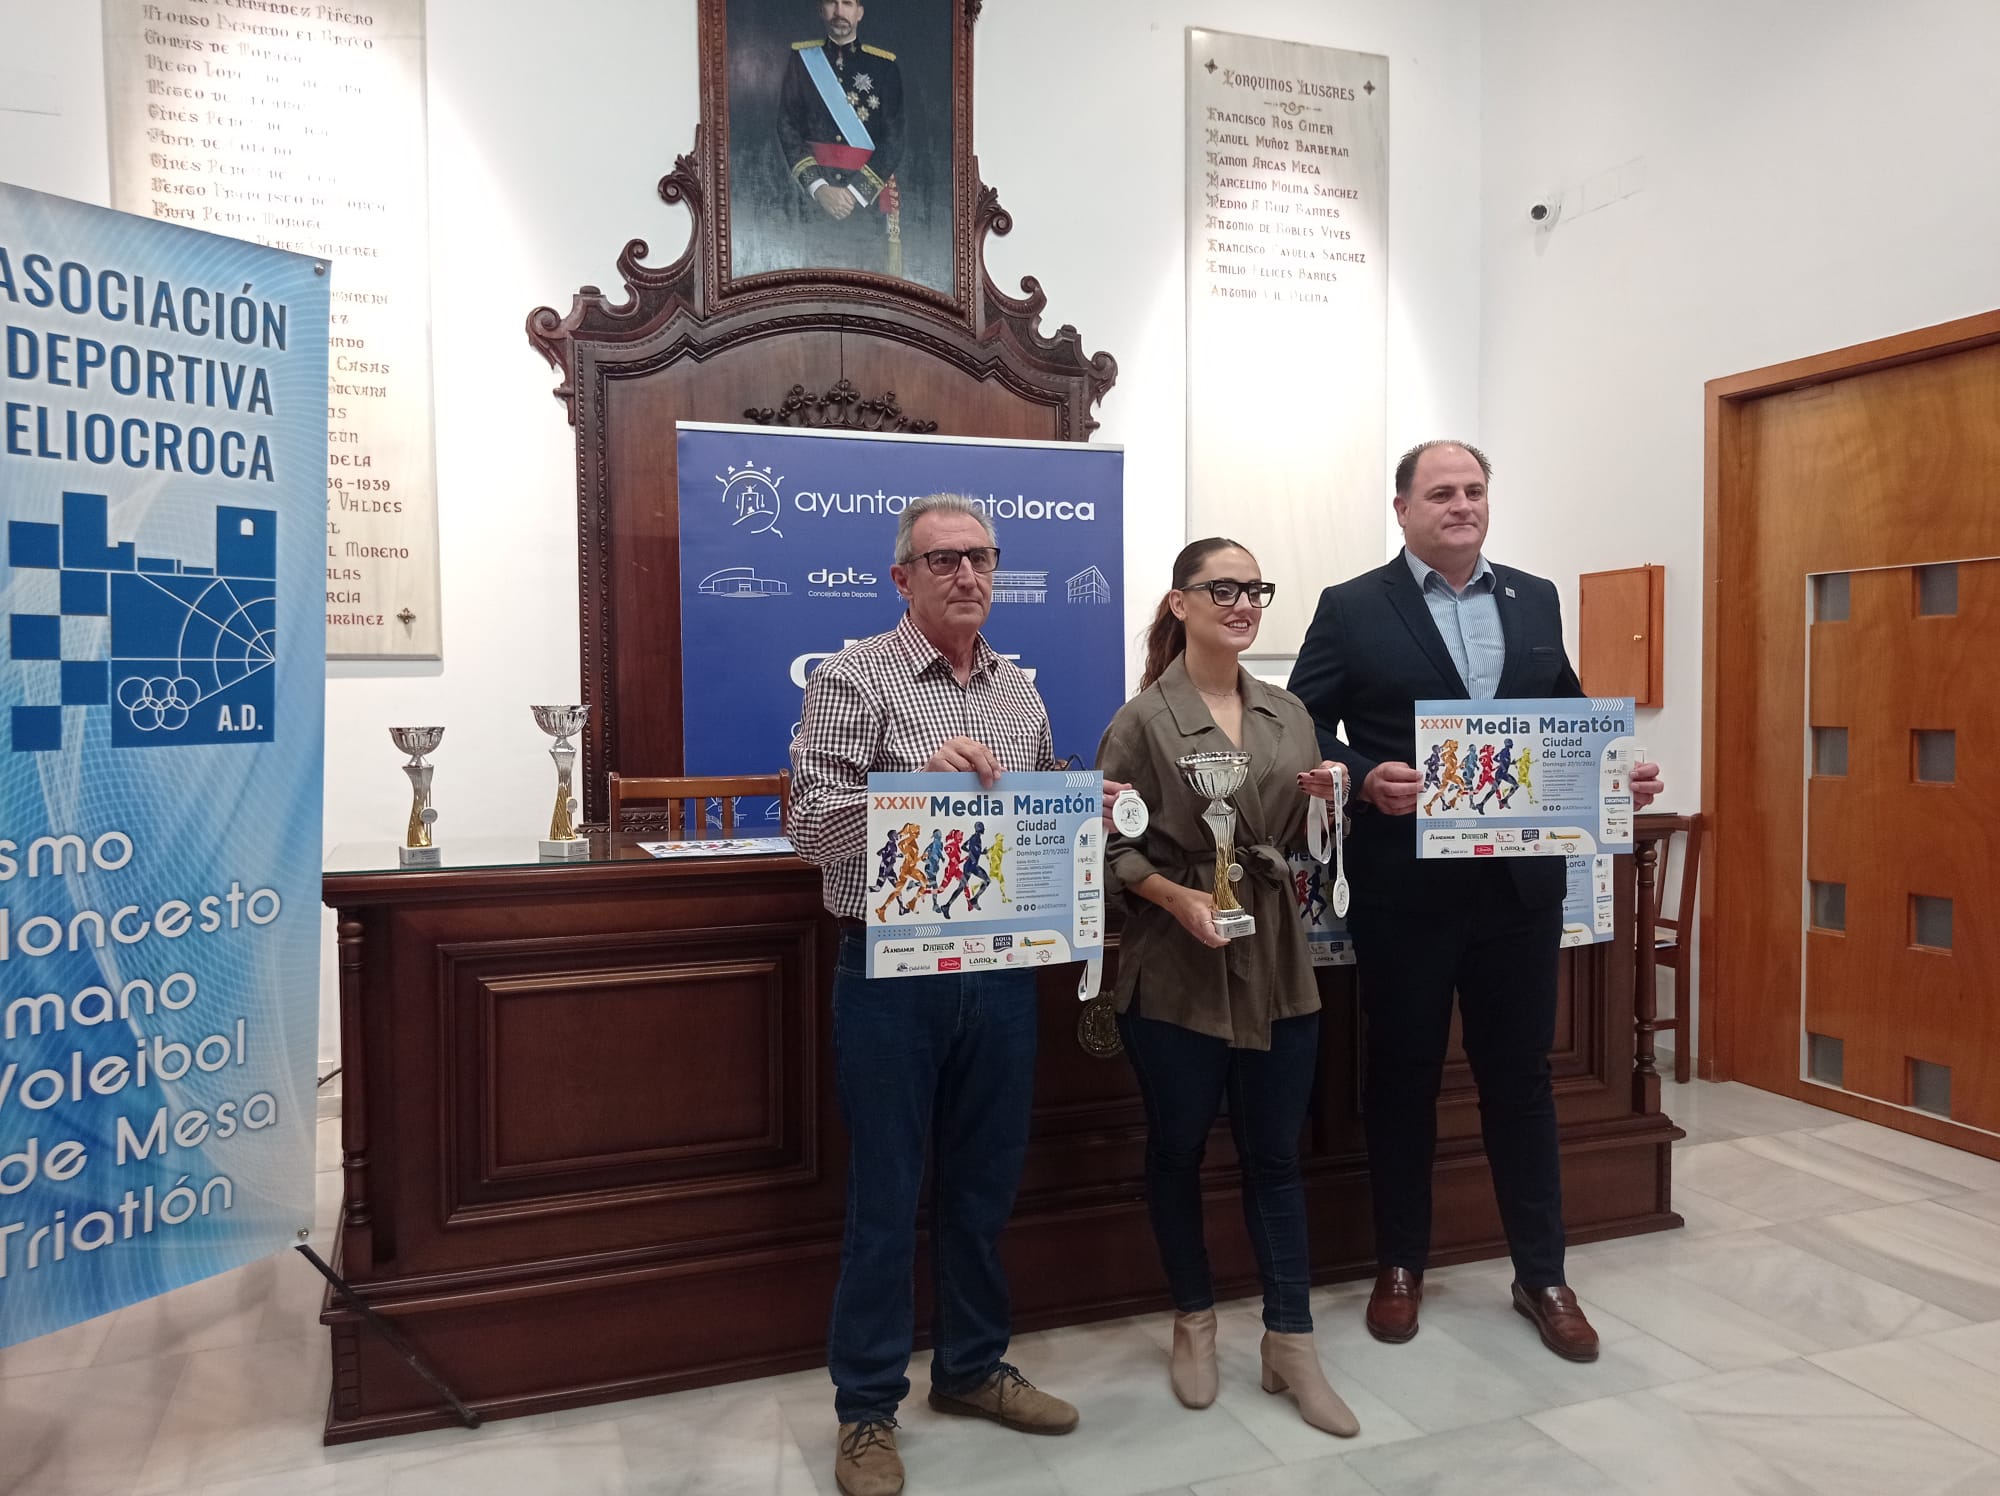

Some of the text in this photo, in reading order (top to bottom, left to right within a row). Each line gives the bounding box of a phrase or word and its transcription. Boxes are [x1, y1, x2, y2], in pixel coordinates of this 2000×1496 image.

[1206, 105, 1334, 136] FRANCISCO ROS GINER
[1205, 127, 1250, 147] MANUEL
[1256, 135, 1290, 151] MUÑOZ
[1206, 151, 1321, 175] RAMON ARCAS MECA
[1205, 170, 1268, 191] MARCELINO
[1313, 184, 1360, 201] SANCHEZ
[1321, 225, 1352, 241] VIVES
[1274, 243, 1316, 259] AYUELA
[6, 324, 275, 418] DEPORTIVA
[6, 400, 276, 484] ELIOCROCA
[794, 489, 1096, 522] ayuntantolorca
[345, 540, 410, 559] MORENO
[807, 566, 878, 588] dpts
[218, 703, 264, 732] A.D.
[1420, 715, 1626, 735] XXXIV Media Maratón
[1542, 736, 1582, 747] Ciudad
[1542, 748, 1591, 759] de Lorca
[873, 792, 1096, 817] XXXIV Media Maratón
[1016, 818, 1057, 832] Ciudad
[1016, 834, 1065, 846] de Lorca
[0, 830, 134, 882] smo
[1016, 849, 1041, 858] Domingo
[5, 972, 197, 1040] mano
[0, 1091, 277, 1196] de Mesa
[0, 1174, 233, 1279] Triatlón
